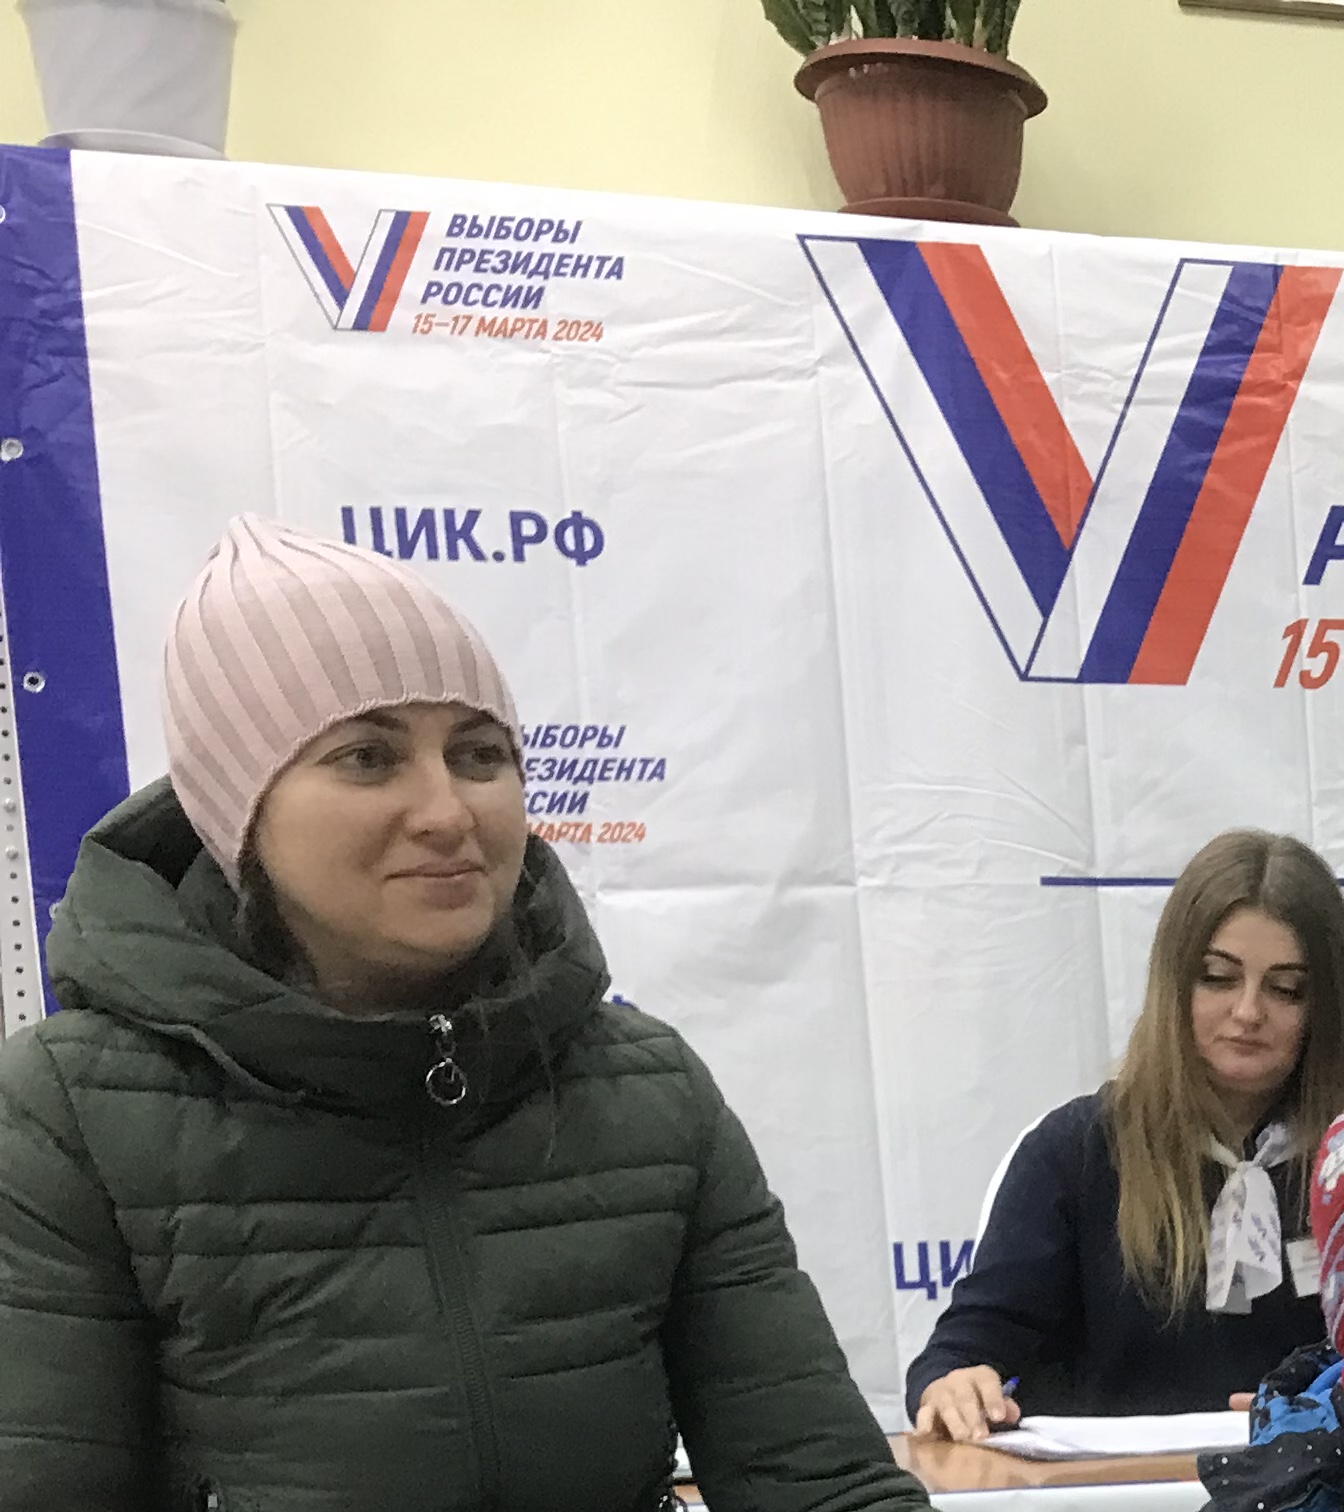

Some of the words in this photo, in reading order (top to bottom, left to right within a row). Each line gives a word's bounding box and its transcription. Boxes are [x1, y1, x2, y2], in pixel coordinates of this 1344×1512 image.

[445, 213, 583, 244] ВЫБОРЫ
[433, 246, 625, 281] ПРЕЗИДЕНТА
[420, 280, 546, 310] РОССИИ
[474, 316, 548, 340] МАРТА
[551, 320, 605, 343] 2024
[340, 504, 605, 567] ЦИК.РФ
[520, 723, 627, 749] ЫБОРЫ
[524, 756, 668, 786] ЕЗИДЕНТА
[596, 821, 648, 844] 2024
